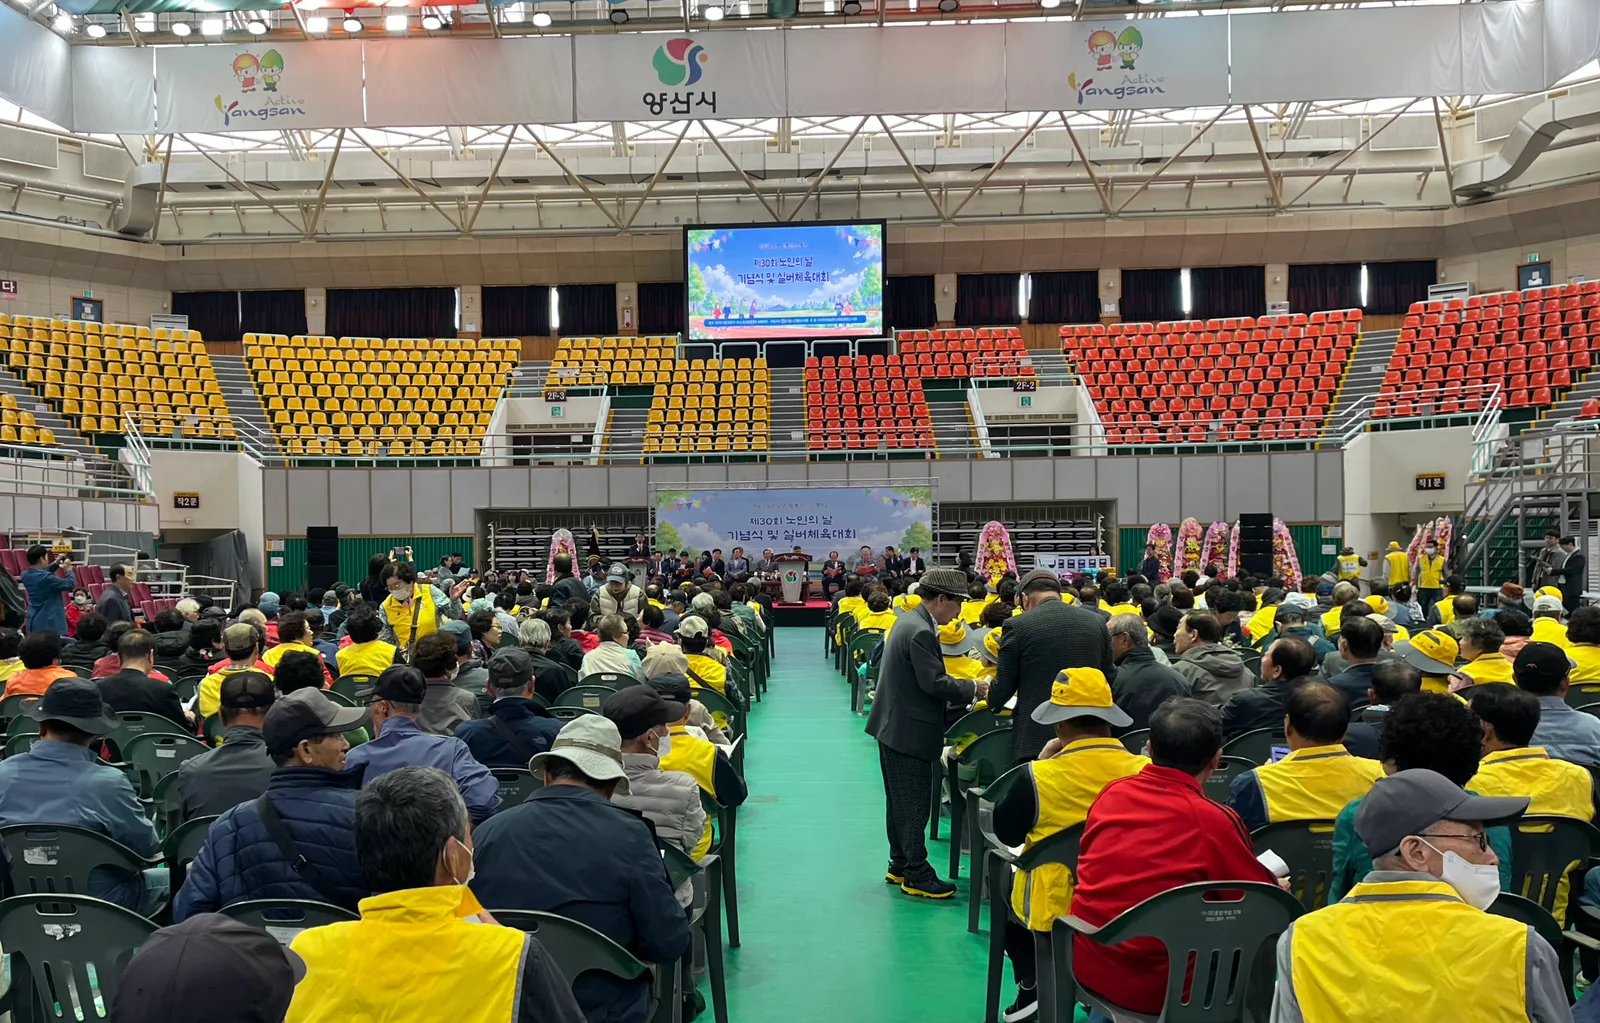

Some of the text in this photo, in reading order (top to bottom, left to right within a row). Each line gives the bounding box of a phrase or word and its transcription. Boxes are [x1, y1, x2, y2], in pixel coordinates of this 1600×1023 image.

[1121, 73, 1165, 85] Active
[264, 95, 305, 106] Active
[642, 91, 717, 116] 양산시
[753, 256, 813, 268] 제30회 노인의 날
[737, 270, 830, 285] 기념식 및 실버체육대회
[2, 281, 15, 293] 다
[1016, 381, 1035, 390] 2F-2
[547, 391, 565, 400] 2F-3
[749, 515, 834, 526] 제30회 노인의 날
[726, 528, 857, 541] 기념식 및 실버체육대회
